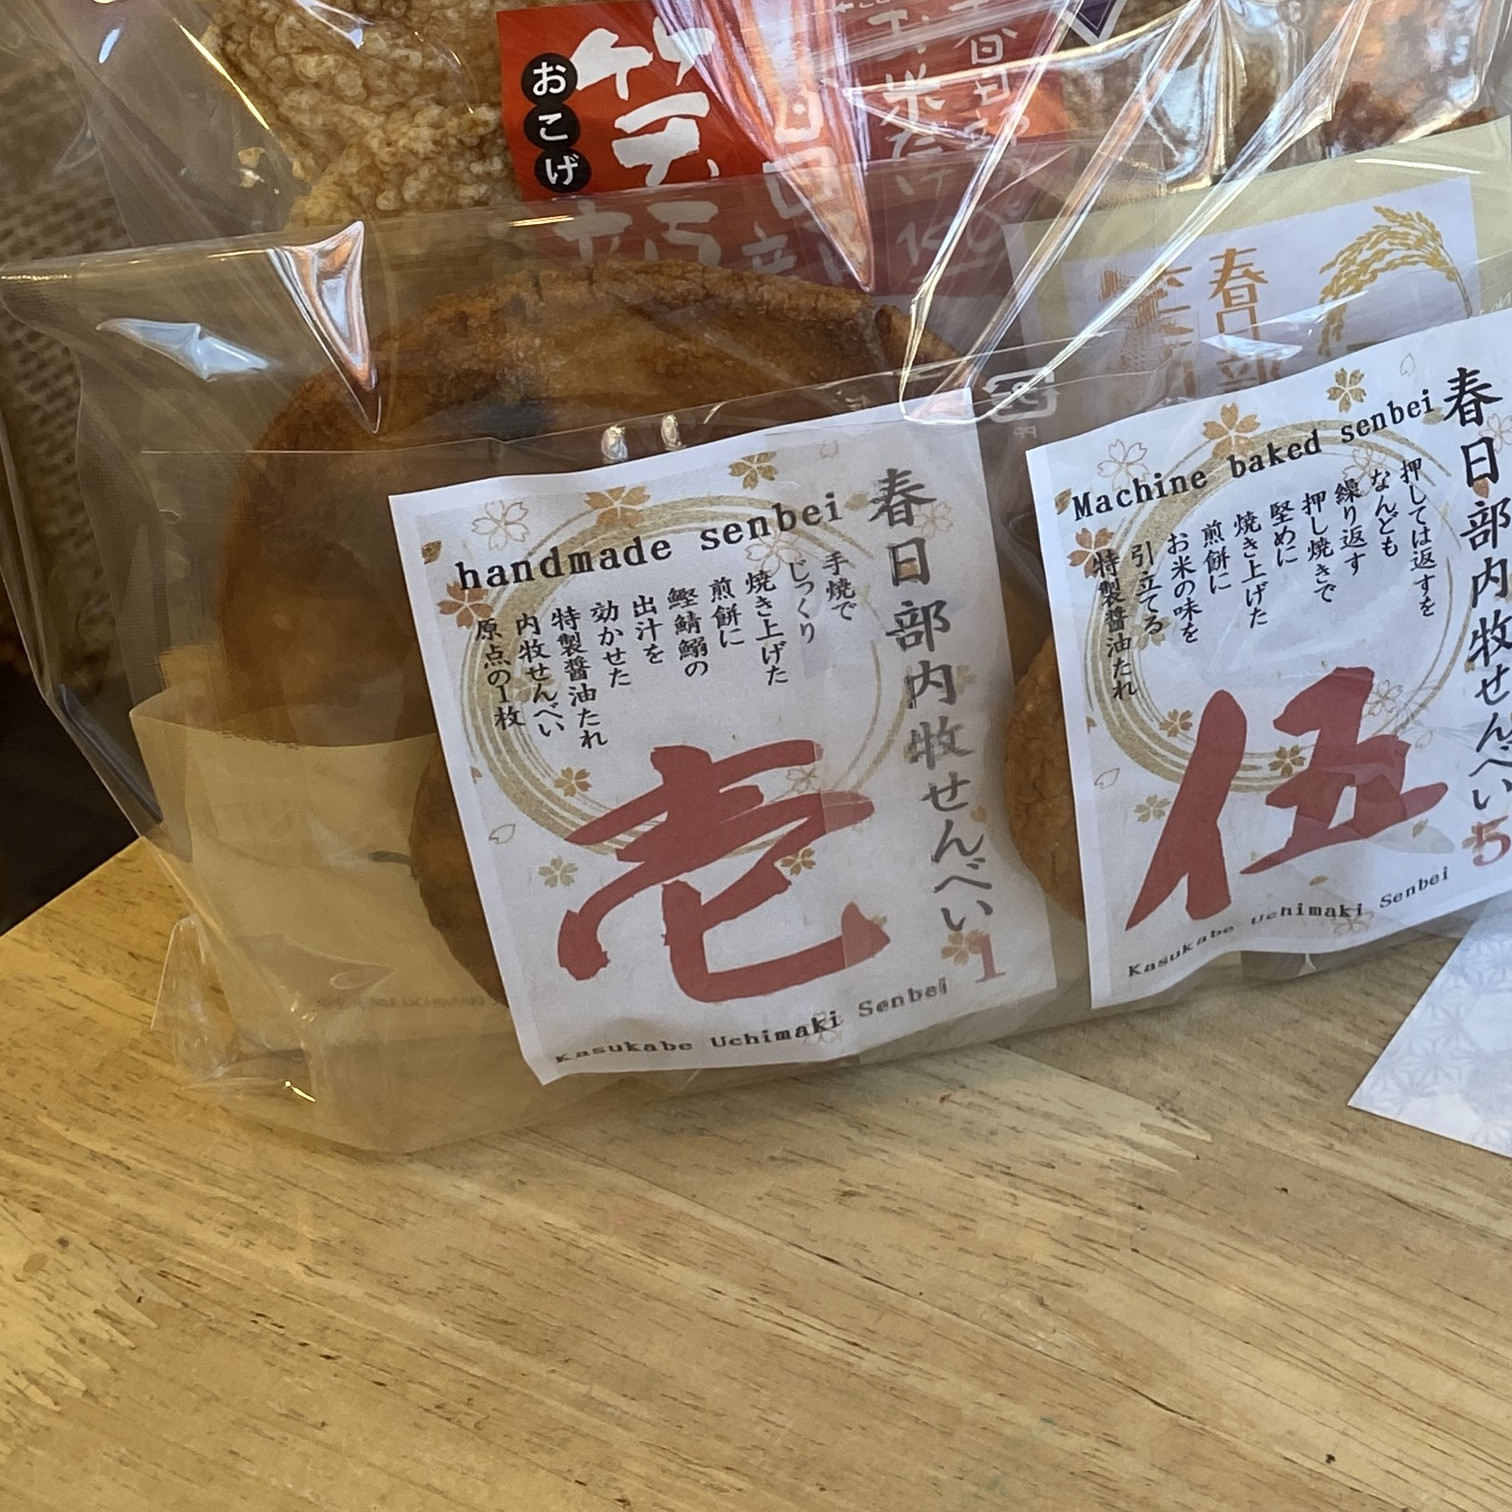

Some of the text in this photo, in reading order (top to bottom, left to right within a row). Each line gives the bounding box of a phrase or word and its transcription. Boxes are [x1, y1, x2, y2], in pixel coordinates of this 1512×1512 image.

[531, 61, 581, 186] おこげ
[1070, 388, 1435, 522] Machine baked senbei
[455, 491, 844, 591] handmade senbei
[1200, 519, 1233, 596] 煎餅に
[1269, 500, 1300, 567] 堅めに
[1301, 490, 1335, 603] 押し焼きで
[1334, 478, 1369, 577] 繰り返す
[1371, 467, 1399, 558] なんども
[1400, 457, 1436, 618] 押しては返すを
[707, 576, 746, 649] 煎餅に
[788, 560, 816, 645] じっくり
[822, 551, 859, 623] 手焼で
[1130, 539, 1165, 636] 引立てる
[1167, 531, 1204, 645] お米の味を
[1233, 511, 1269, 630] 焼き上げた
[591, 600, 632, 689] 効かせた
[631, 594, 666, 666] 出汁を
[744, 568, 790, 687] 焼き上げた
[1093, 547, 1138, 701] 特製醤油たれ
[515, 612, 566, 737] 内牧せんべい
[551, 605, 609, 750] 特製醤油たれ
[868, 468, 993, 932] 春日部内牧せんべい
[1125, 665, 1449, 931] 伍
[1472, 815, 1512, 867] 5
[969, 932, 1006, 984] 1
[1127, 866, 1449, 977] Kasukabe Uchimaki Senbei
[554, 977, 948, 1063] Kasukabe Uchimaki Senbei
